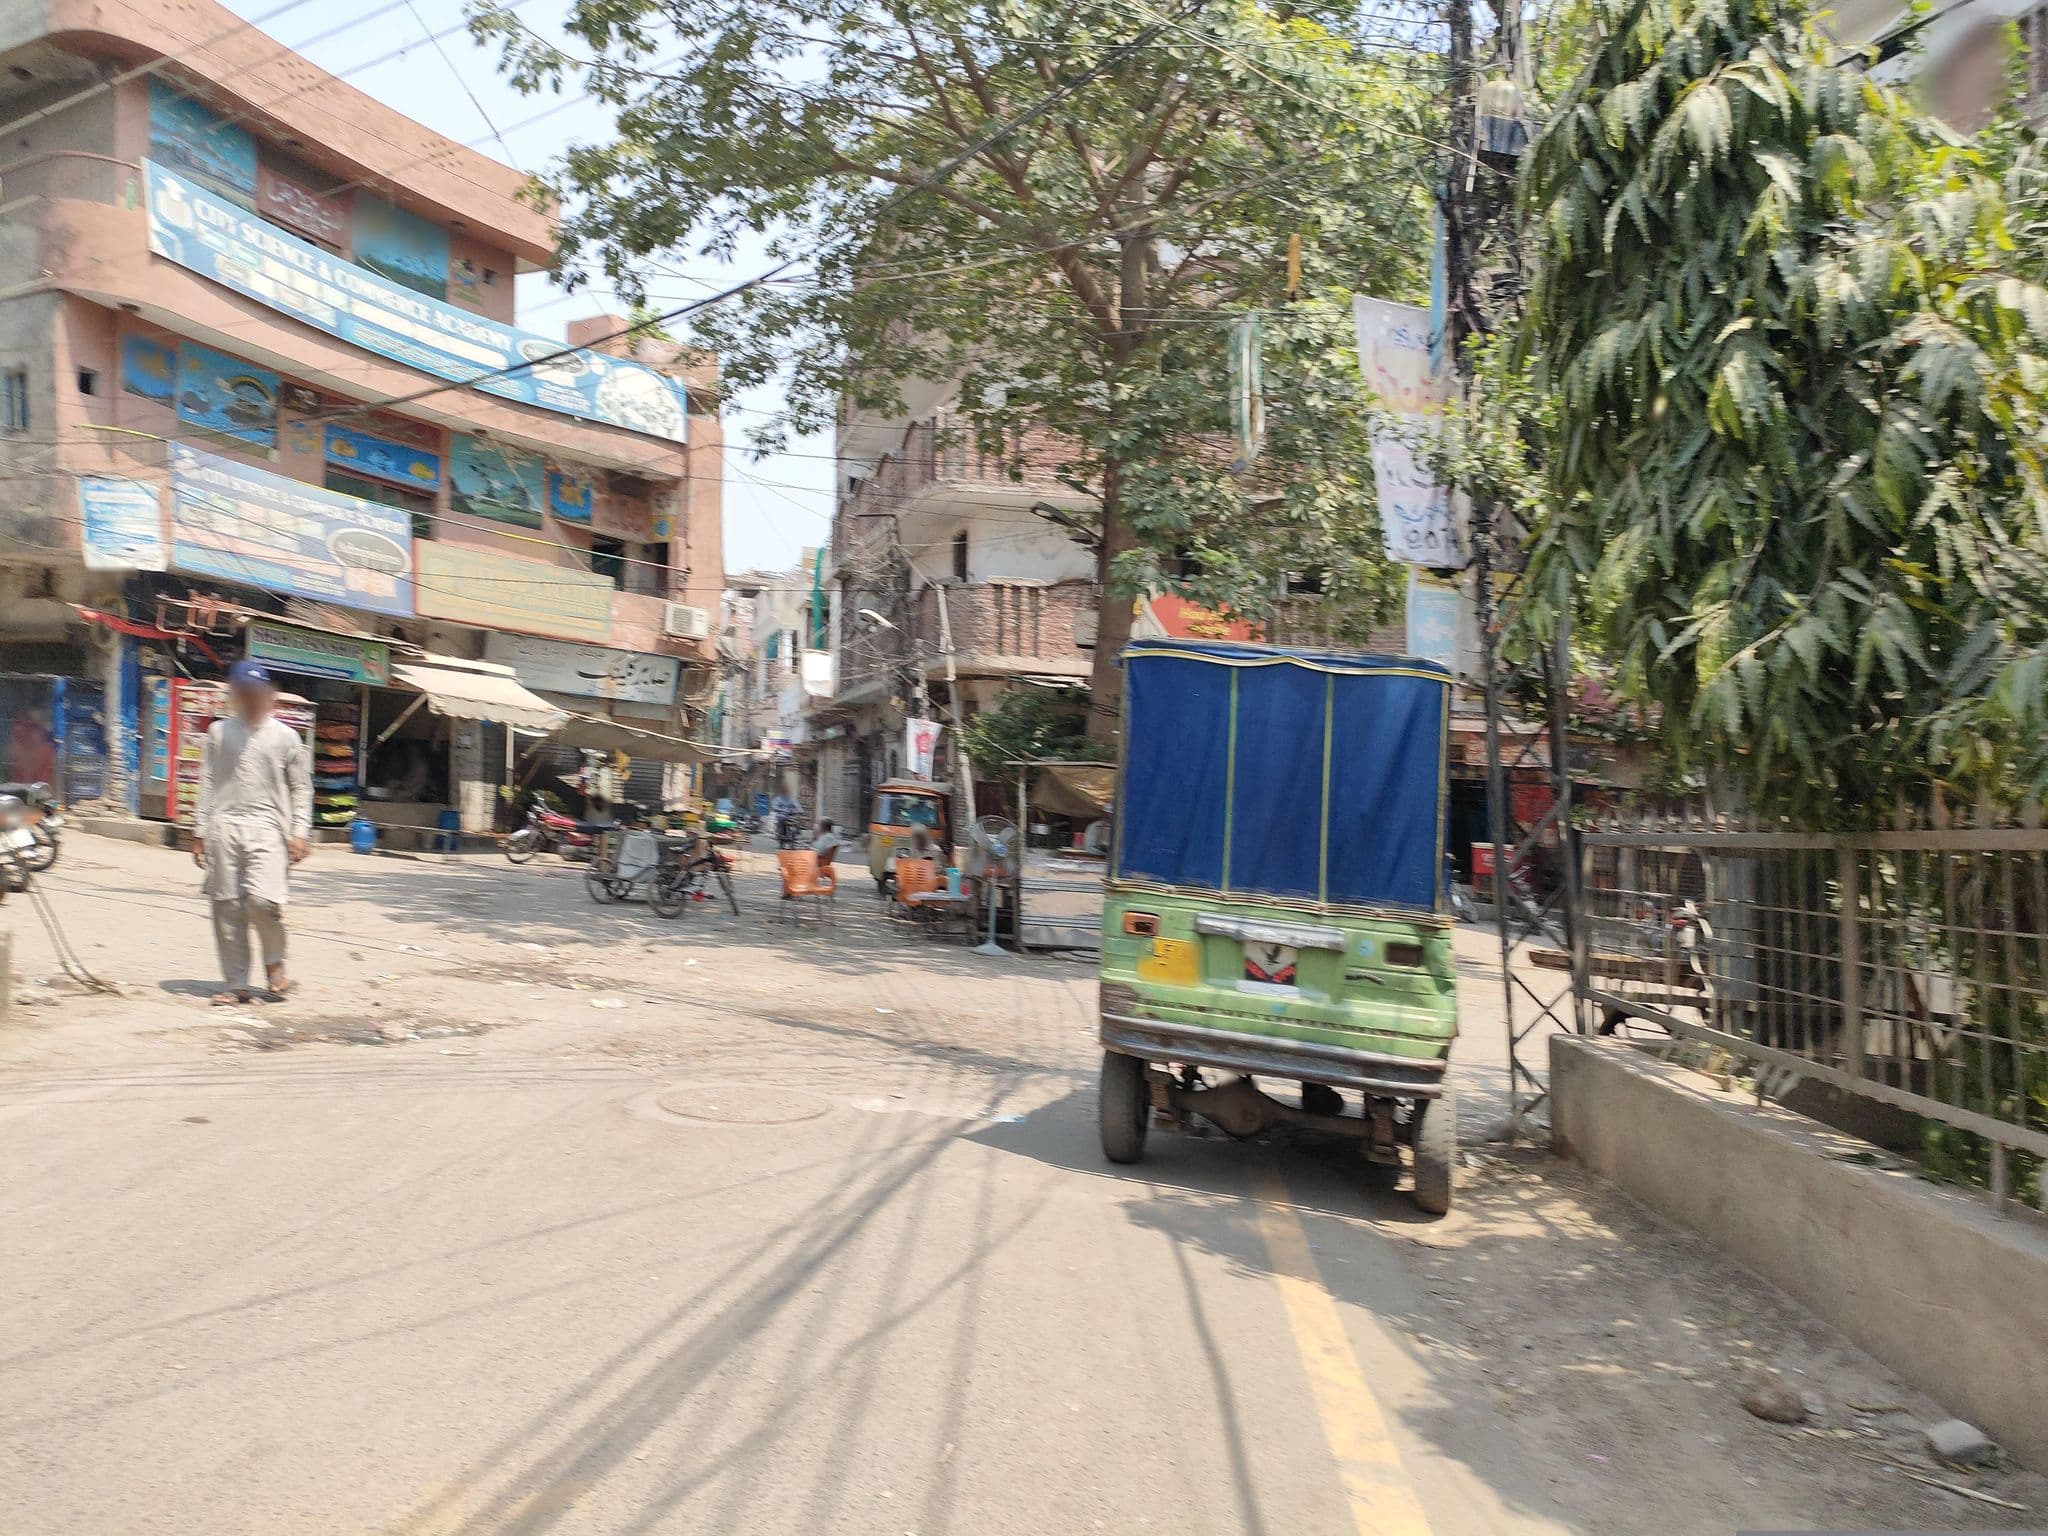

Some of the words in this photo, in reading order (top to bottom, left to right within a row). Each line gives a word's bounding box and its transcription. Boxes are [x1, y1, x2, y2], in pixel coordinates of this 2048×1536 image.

[193, 198, 237, 236] CITY
[240, 223, 314, 273] SCIENCE
[317, 260, 332, 282] &
[334, 268, 431, 324] COMMERCE
[432, 309, 513, 352] ACADEMY
